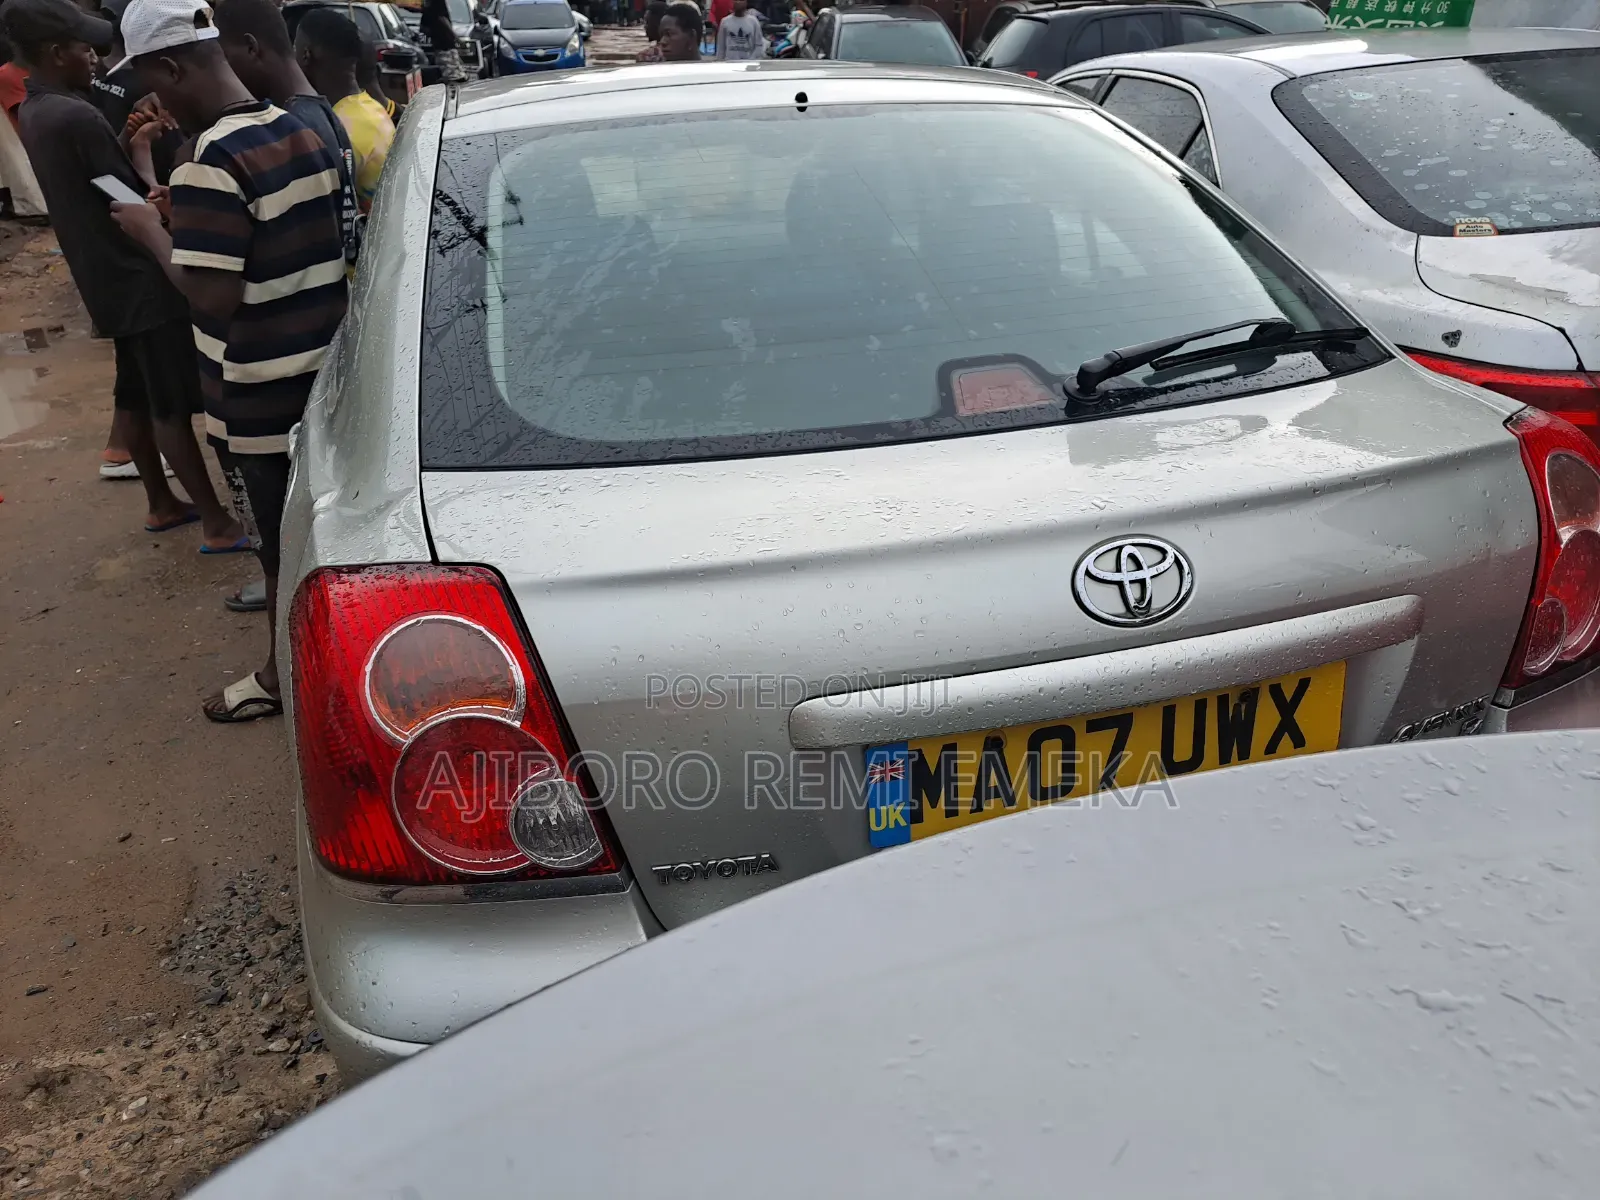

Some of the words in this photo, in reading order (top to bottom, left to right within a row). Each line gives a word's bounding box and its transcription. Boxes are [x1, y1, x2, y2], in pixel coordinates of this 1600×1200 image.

[1160, 676, 1312, 776] UWX
[869, 802, 908, 832] UK
[651, 853, 780, 885] TOYOTA
